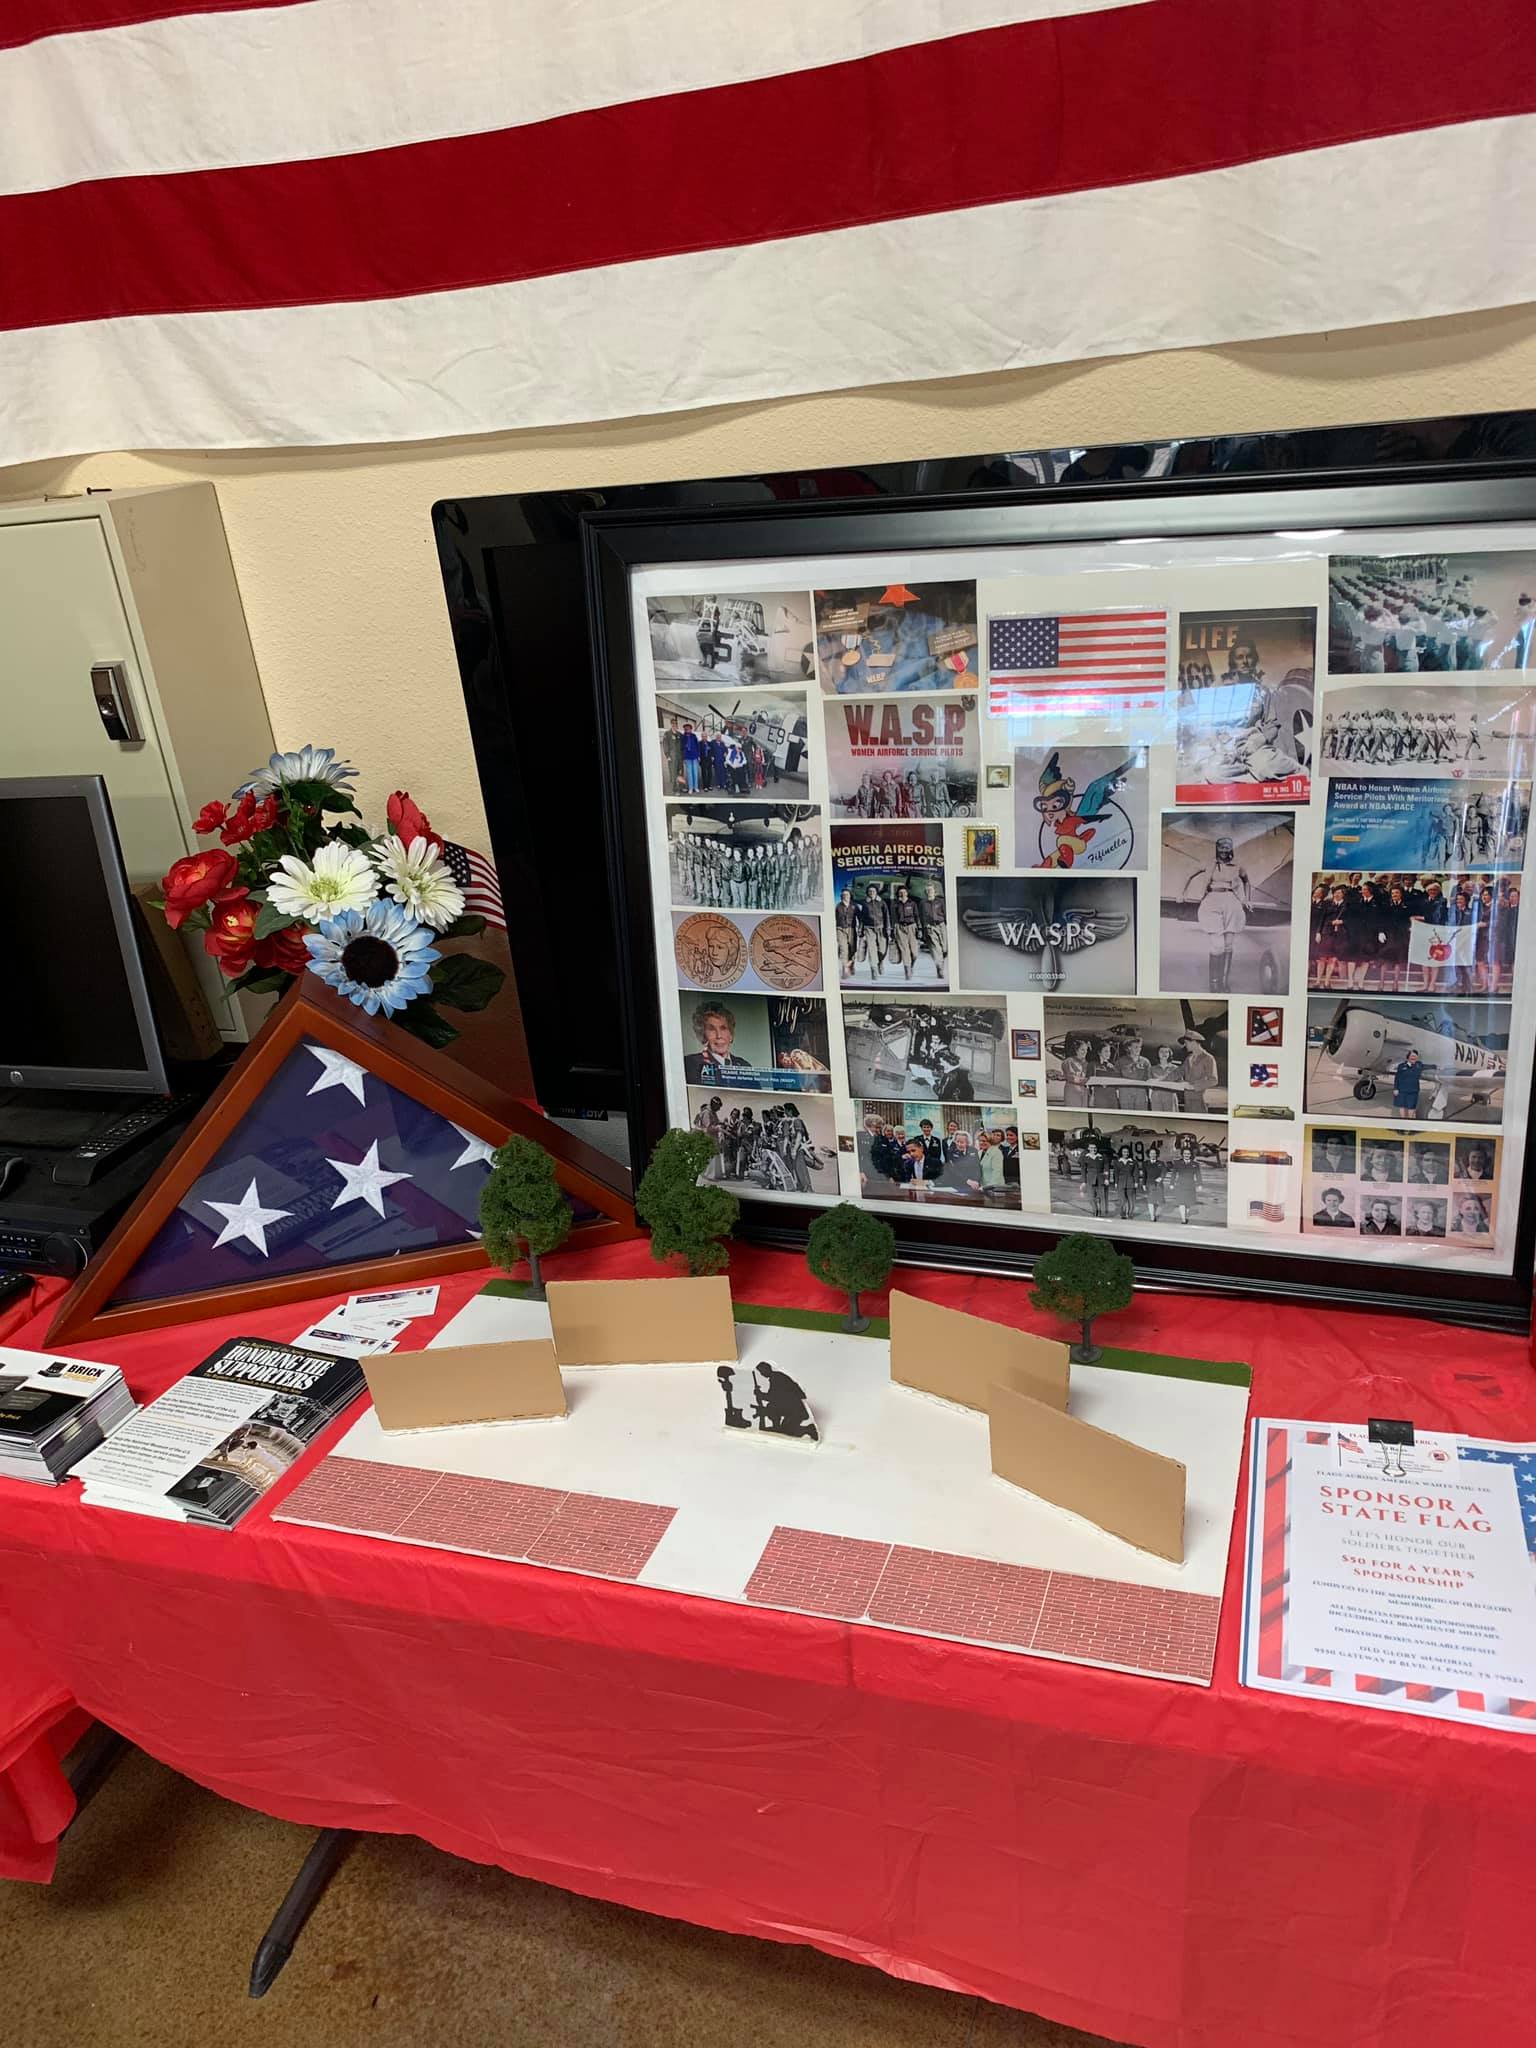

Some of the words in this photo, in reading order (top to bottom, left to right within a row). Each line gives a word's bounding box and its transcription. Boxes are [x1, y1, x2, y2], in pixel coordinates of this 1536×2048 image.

[1186, 623, 1240, 650] LIFE
[844, 704, 966, 746] W.A.S.P.
[851, 748, 876, 757] WOMEN
[877, 748, 909, 757] AIRFORCE
[911, 748, 938, 757] SERVICE
[940, 748, 964, 757] PILOTS
[1291, 779, 1302, 793] 10
[1335, 783, 1358, 791] NBAA
[1369, 783, 1391, 792] Honor
[1393, 785, 1420, 793] Women
[1364, 793, 1386, 801] Pilots
[1333, 801, 1359, 809] Award
[831, 844, 880, 857] WOMEN
[837, 855, 894, 868] SERVICE
[897, 856, 944, 867] PILOTS
[1087, 838, 1128, 864] Fifinella
[998, 922, 1097, 946] WASPS
[1455, 1042, 1486, 1067] NAVY
[66, 1364, 105, 1378] BRICK
[223, 1345, 302, 1370] HONORING
[296, 1357, 337, 1377] THE
[206, 1359, 320, 1391] SUPPORTERS
[1345, 1472, 1380, 1482] ACROSS
[1381, 1477, 1420, 1486] AMERICA
[1319, 1485, 1455, 1512] SPONSOR
[1466, 1502, 1483, 1515] A
[1321, 1502, 1407, 1524] STATE
[1419, 1513, 1493, 1533] FLAG
[1341, 1538, 1402, 1553] SOLDIERS
[1407, 1546, 1475, 1560] TOGETHER
[1349, 1529, 1380, 1540] LET'S
[1385, 1534, 1433, 1546] HONOR
[1438, 1540, 1465, 1549] OUR
[1341, 1554, 1366, 1565] $50
[1371, 1559, 1402, 1570] FOR
[1407, 1564, 1417, 1572] A
[1422, 1565, 1475, 1579] YEAR'S
[1353, 1567, 1464, 1589] SPONSORSHIP
